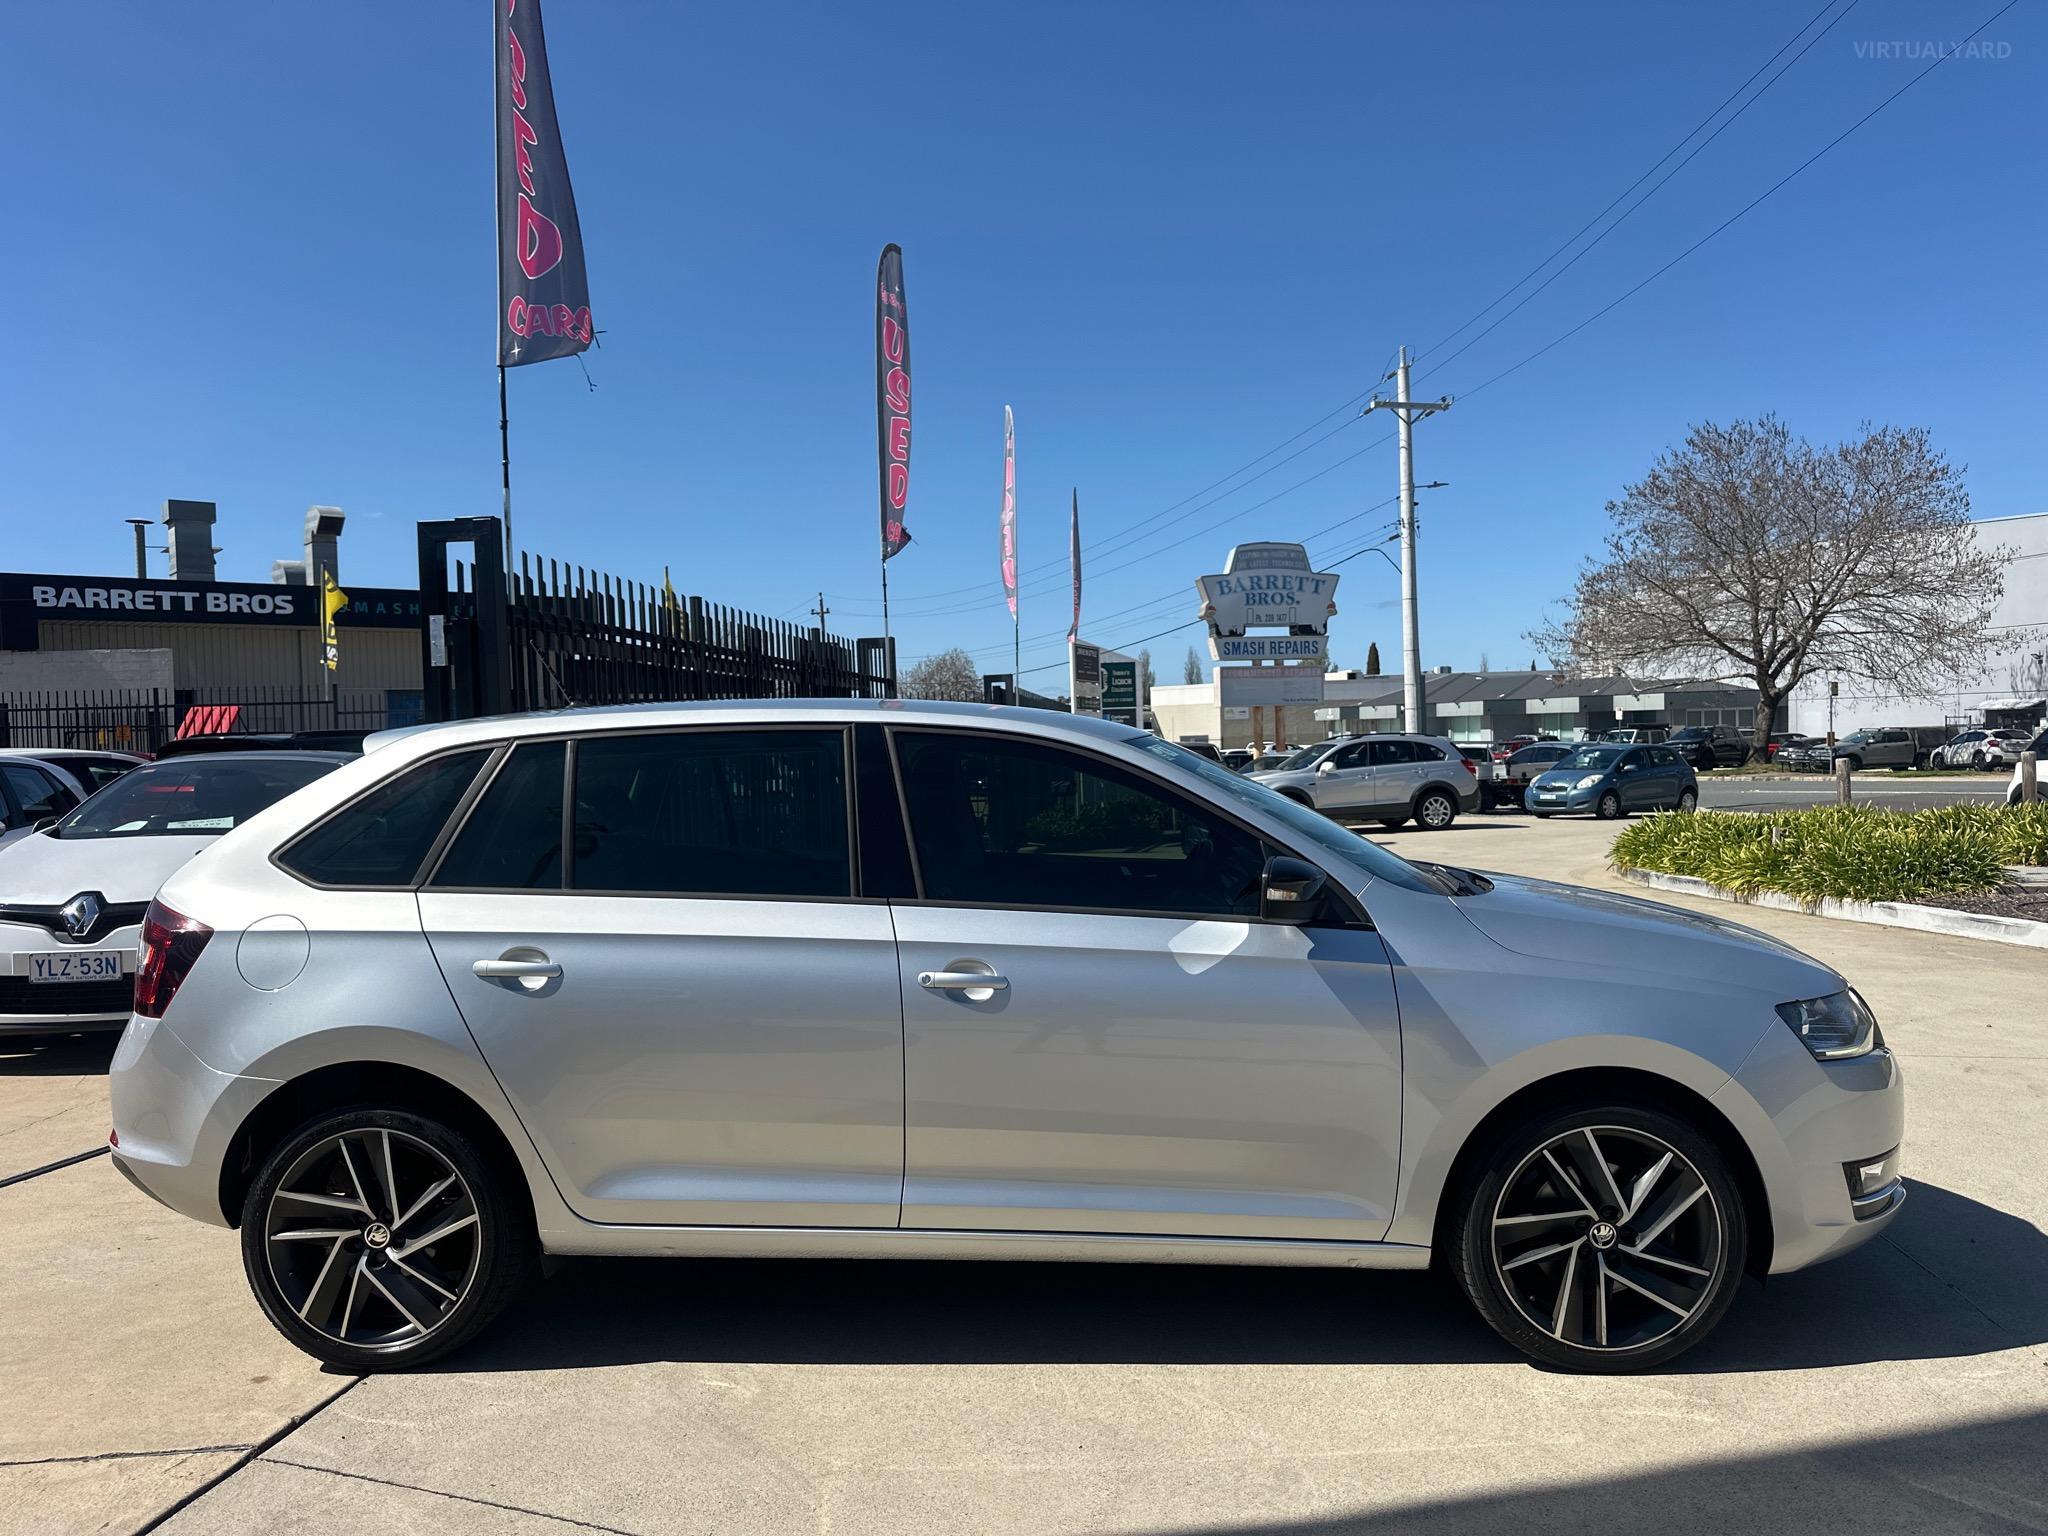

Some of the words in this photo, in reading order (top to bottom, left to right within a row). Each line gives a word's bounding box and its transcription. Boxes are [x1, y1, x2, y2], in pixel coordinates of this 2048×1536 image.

[507, 295, 593, 344] CARS
[883, 316, 911, 509] USED
[1216, 574, 1326, 596] BARRETT
[32, 586, 200, 612] BARRETT
[206, 592, 294, 615] BROS
[1245, 591, 1301, 606] BROS.
[1223, 641, 1265, 656] SMASH
[1269, 640, 1319, 655] REPAIRS
